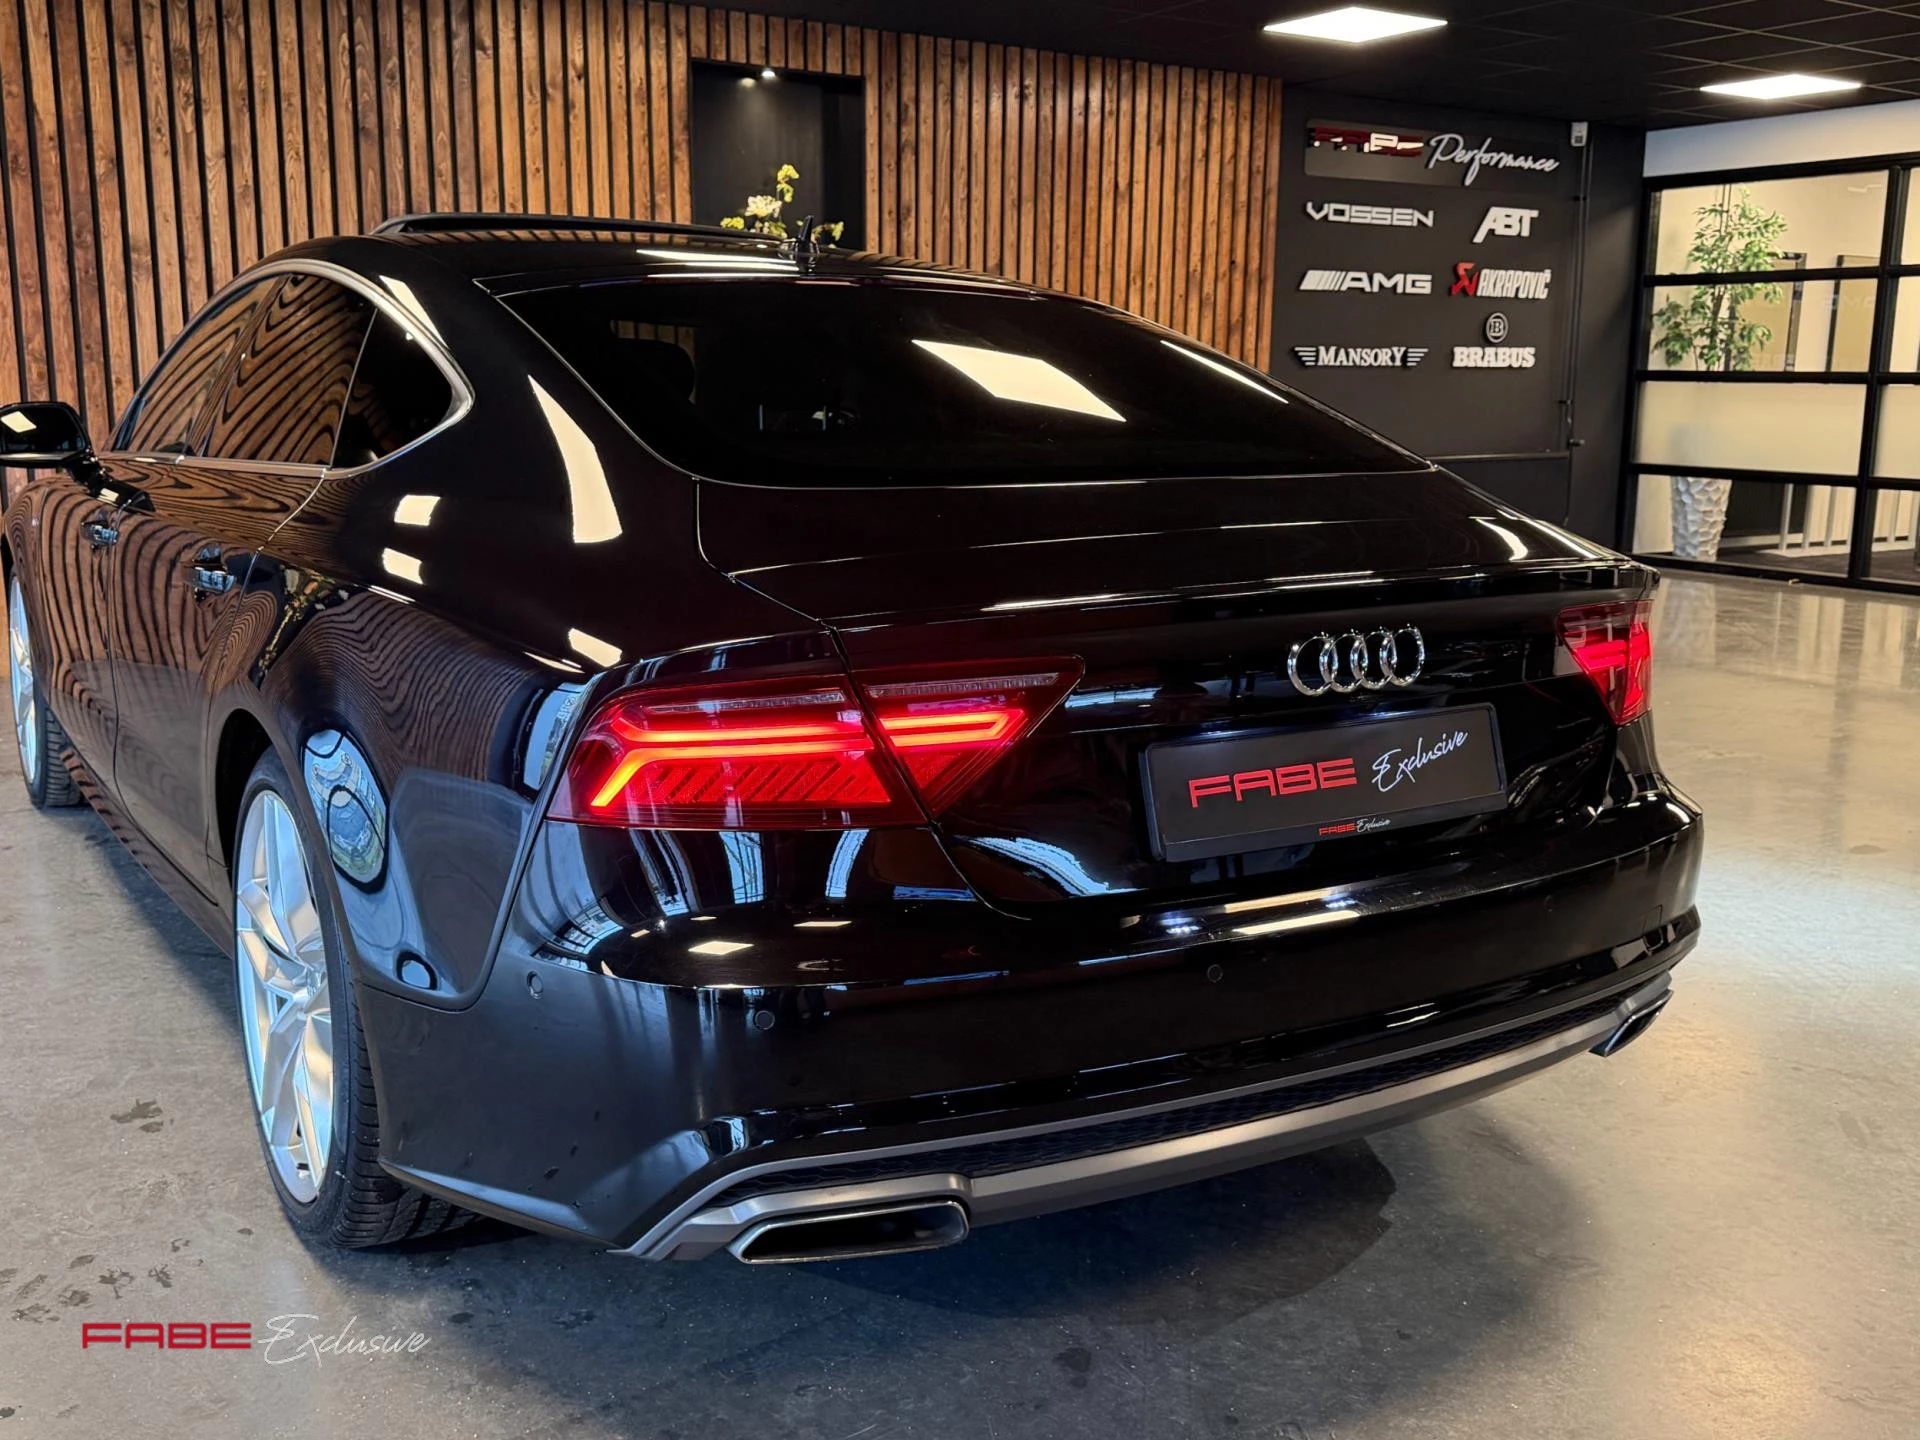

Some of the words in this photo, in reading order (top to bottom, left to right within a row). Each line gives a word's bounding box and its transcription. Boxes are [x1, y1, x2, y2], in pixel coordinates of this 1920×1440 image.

[1429, 133, 1560, 186] Performance
[1306, 201, 1434, 227] VOSSEN
[1472, 206, 1539, 243] ABT
[1340, 271, 1433, 295] AMG
[1317, 346, 1407, 367] MANSORY
[1452, 346, 1536, 368] BRABUS
[1188, 757, 1358, 808] FABE
[1371, 729, 1468, 793] Exclusive
[1318, 823, 1356, 837] FABE
